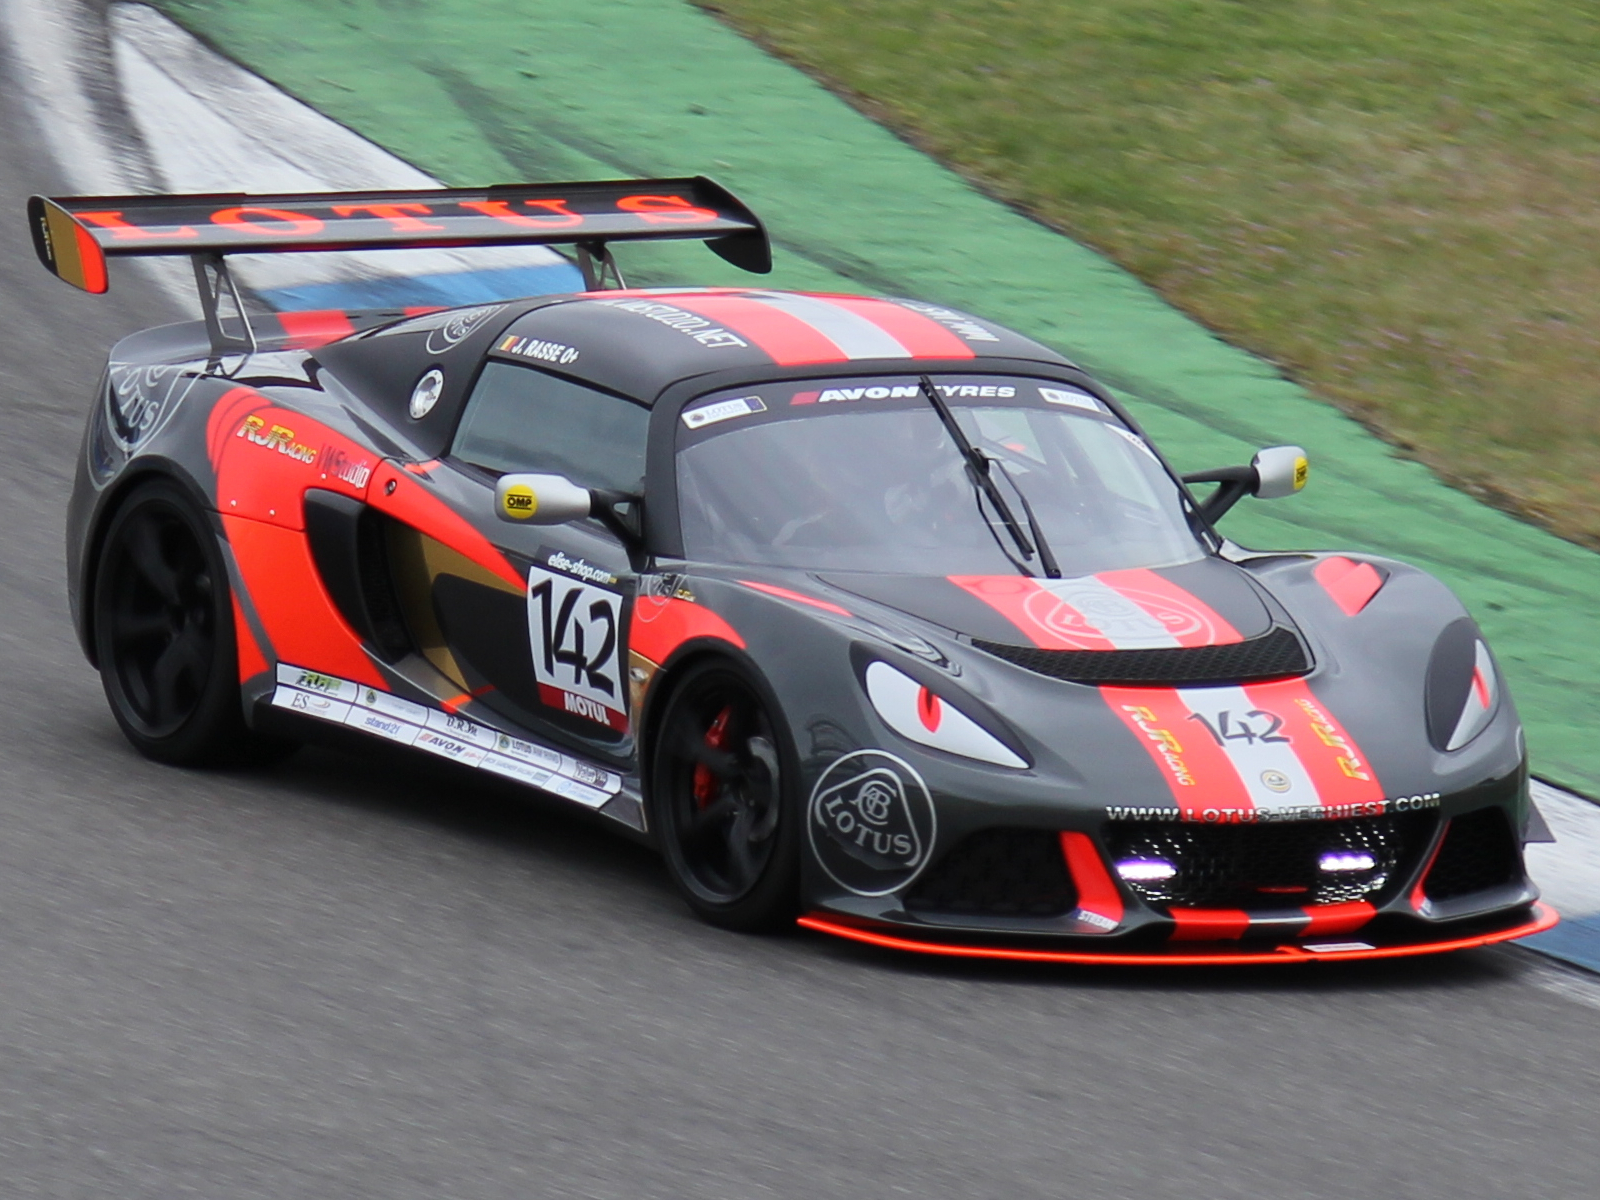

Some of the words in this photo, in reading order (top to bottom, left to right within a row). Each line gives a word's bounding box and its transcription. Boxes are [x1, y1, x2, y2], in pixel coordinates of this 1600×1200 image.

[72, 195, 719, 240] LOTUS
[511, 336, 528, 355] J.
[522, 339, 566, 362] RASSE
[818, 386, 919, 402] AVON
[507, 496, 533, 507] OMP
[547, 551, 612, 584] elise-shop.com
[531, 577, 616, 701] 142
[563, 691, 612, 727] MOTUL
[428, 737, 466, 754] AVON
[1187, 710, 1291, 748] 142
[825, 795, 913, 856] LOTUS
